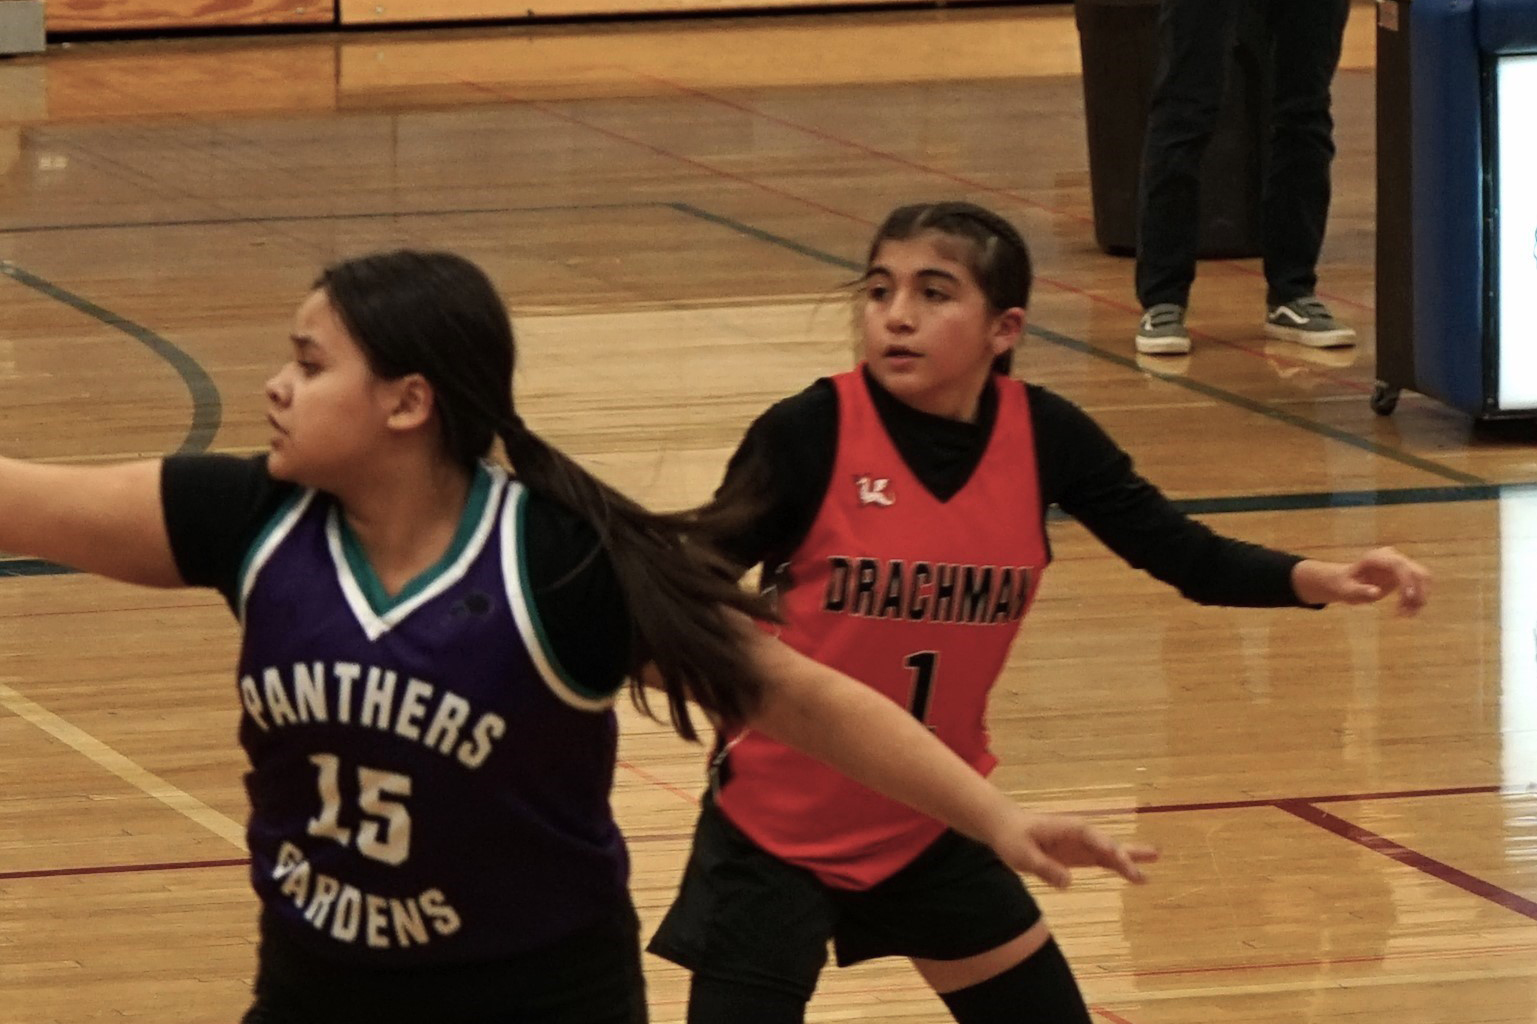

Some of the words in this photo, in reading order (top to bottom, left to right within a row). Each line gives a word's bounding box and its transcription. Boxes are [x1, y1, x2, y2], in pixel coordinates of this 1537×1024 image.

[241, 661, 506, 769] PANTHERS
[903, 650, 940, 736] 1
[306, 752, 412, 867] 15
